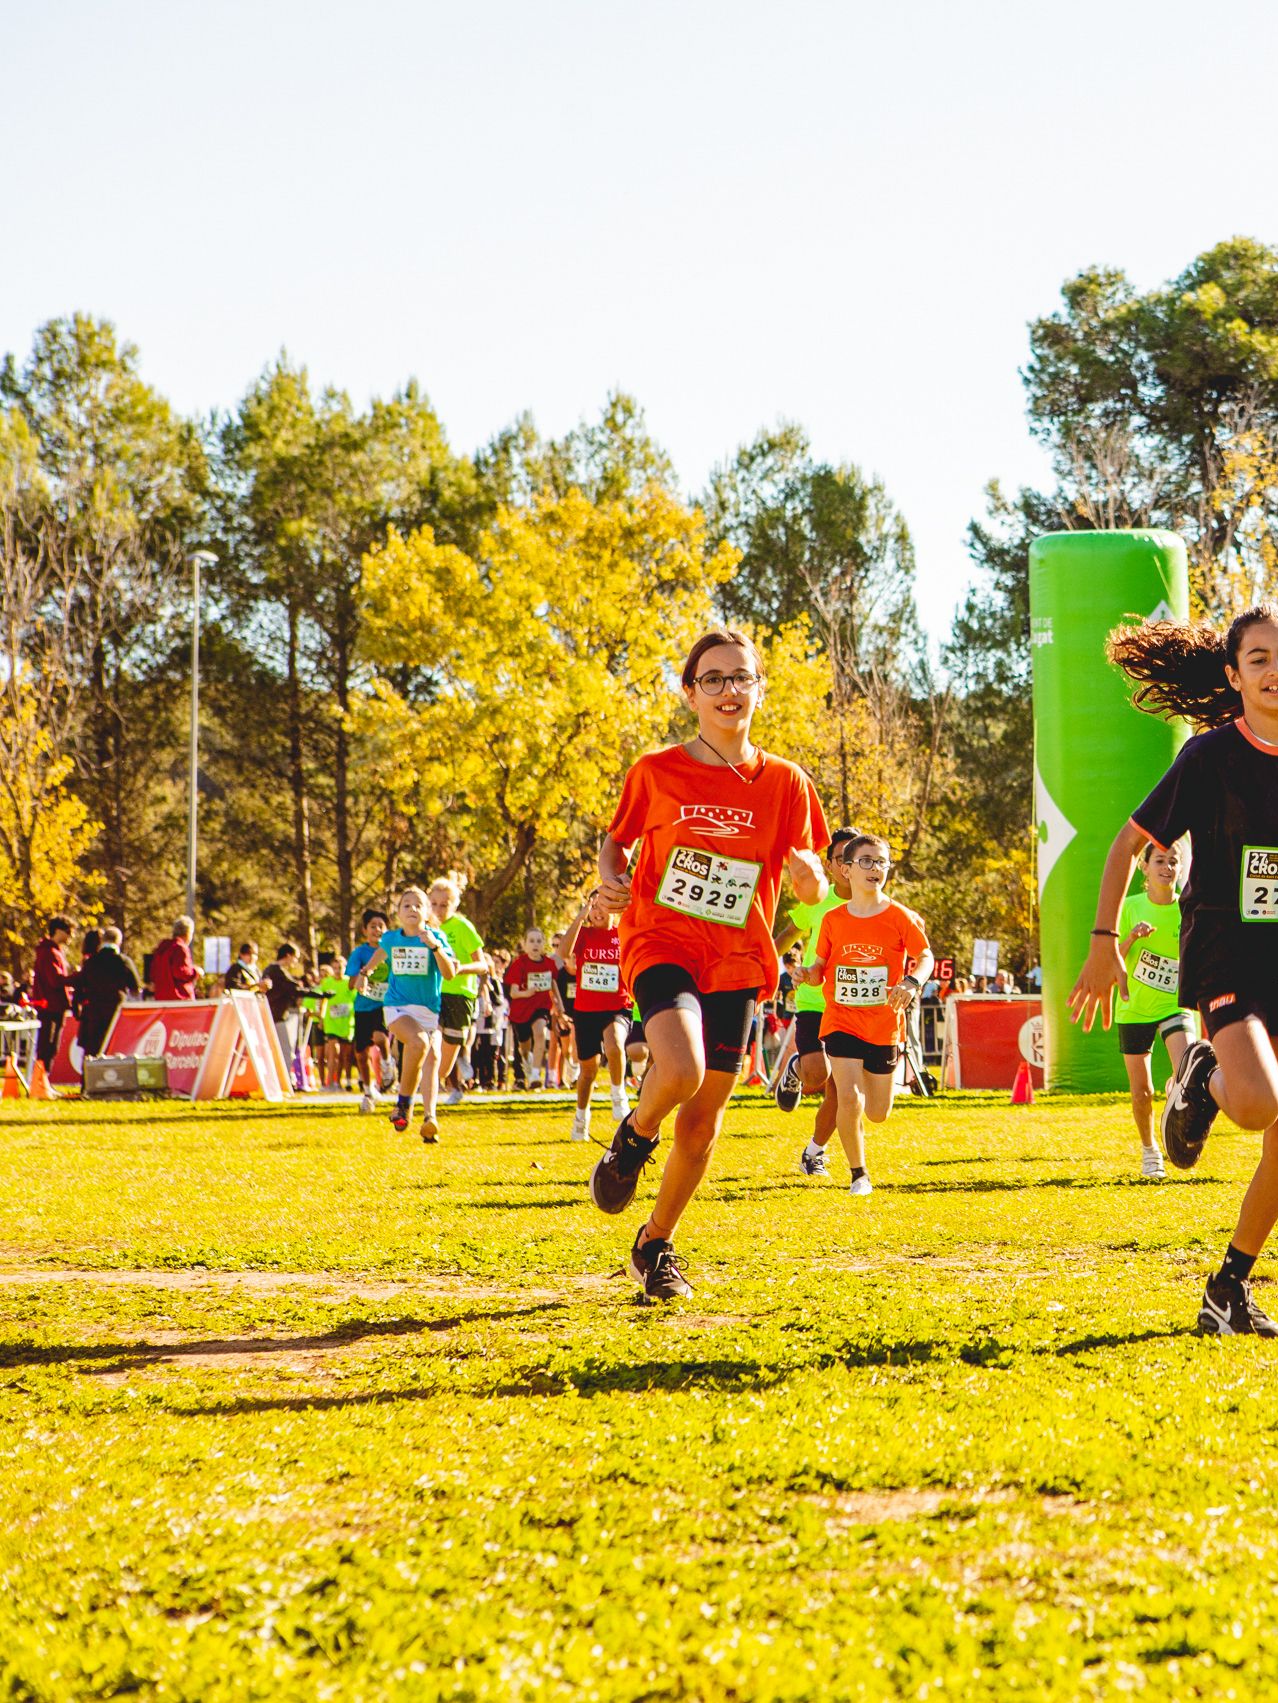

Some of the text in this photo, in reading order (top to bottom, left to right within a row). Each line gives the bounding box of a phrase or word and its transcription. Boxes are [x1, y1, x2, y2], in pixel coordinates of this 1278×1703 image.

[676, 854, 709, 876] CROS
[671, 878, 737, 910] 2929
[1142, 967, 1172, 985] 1015
[841, 986, 880, 998] 2928
